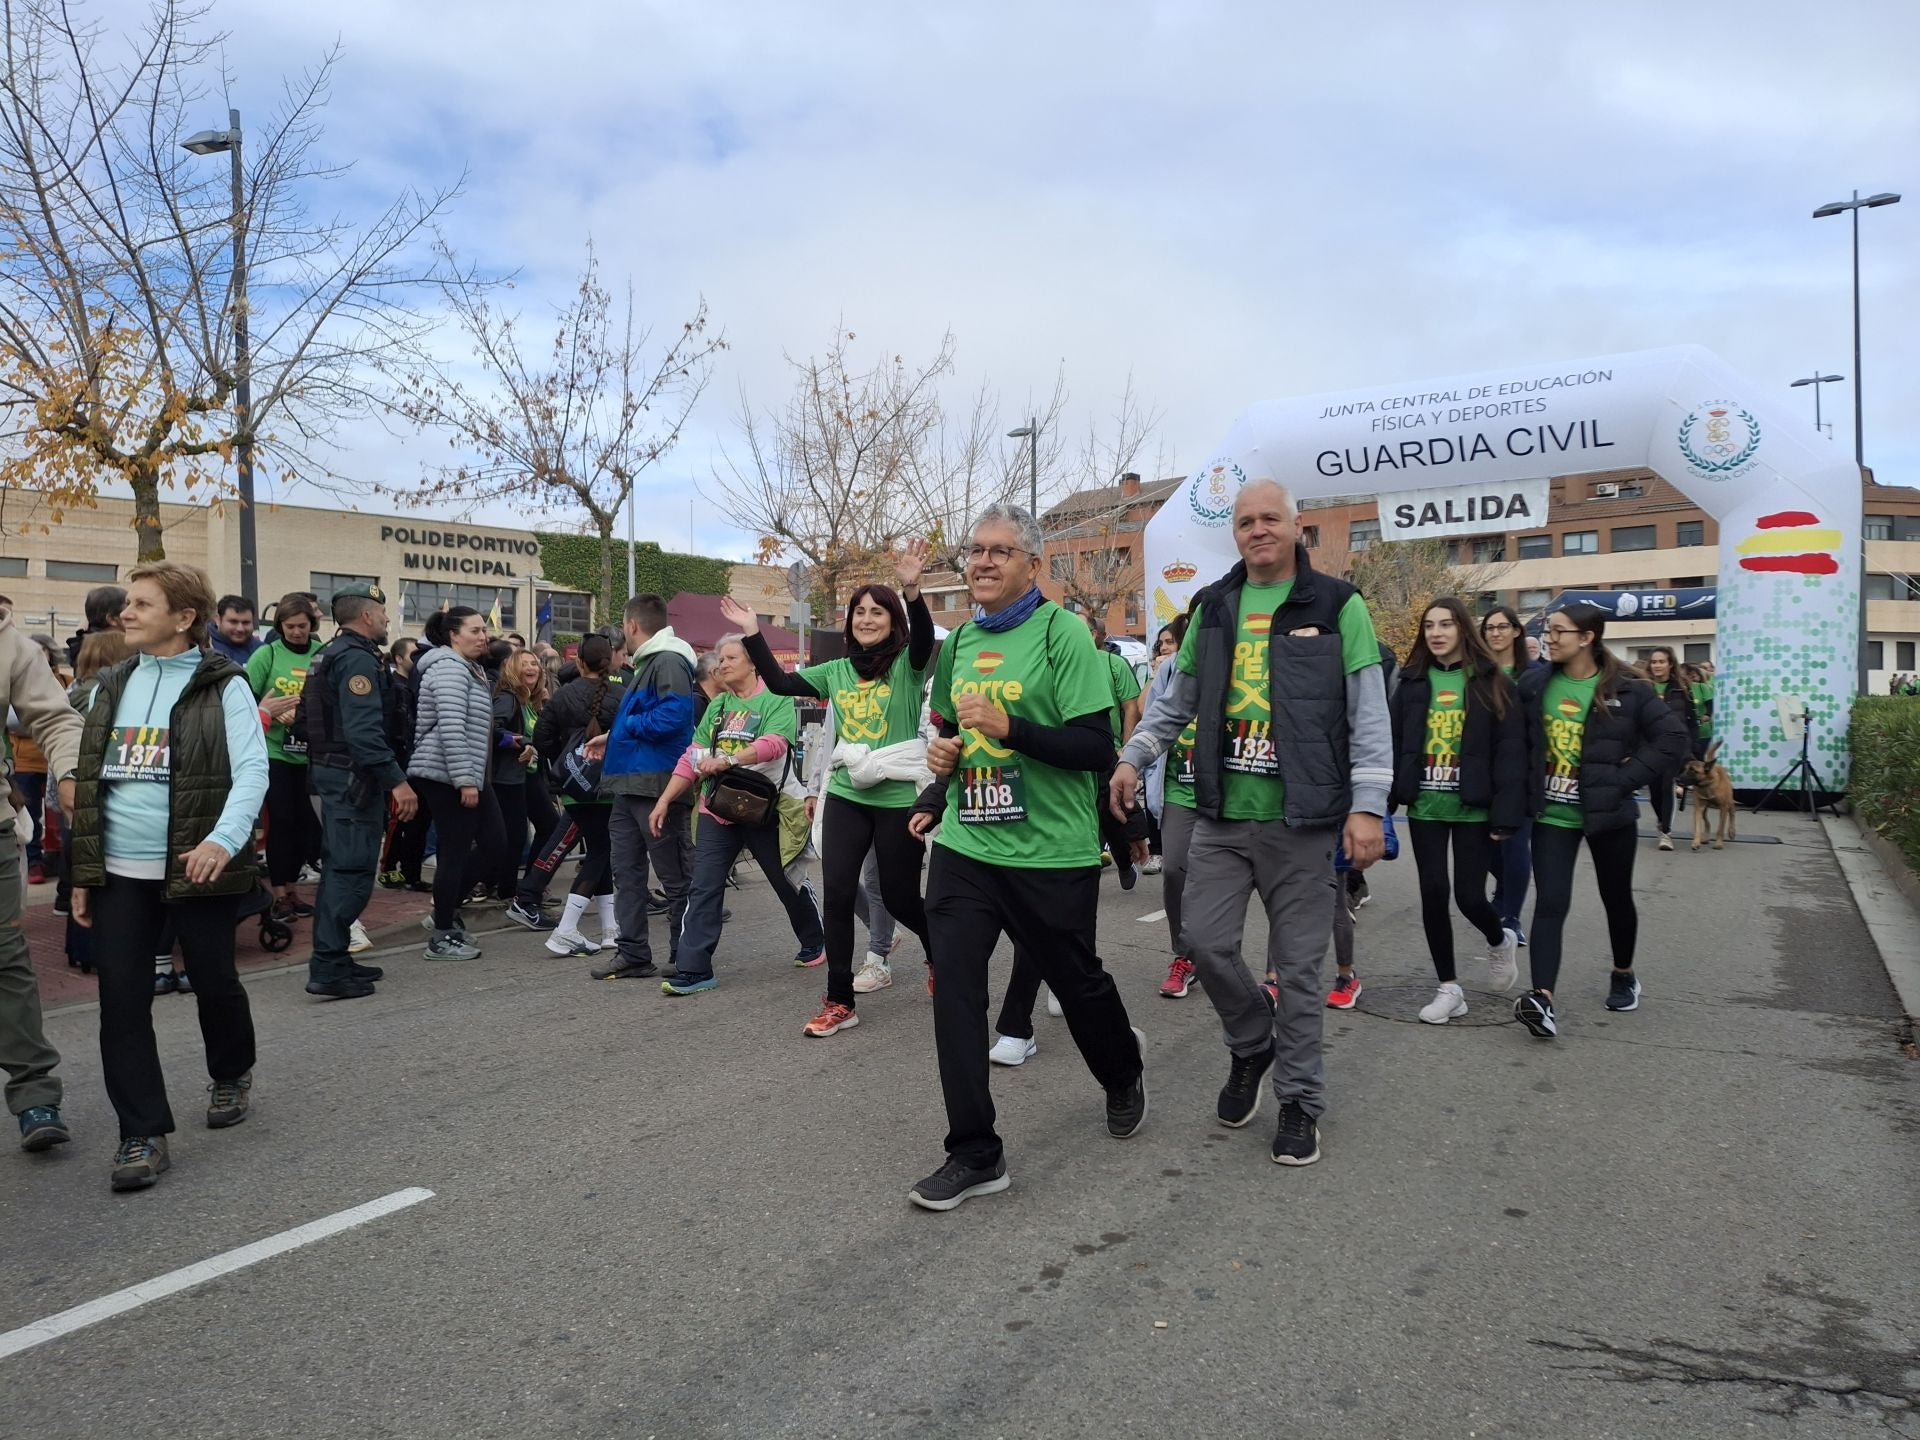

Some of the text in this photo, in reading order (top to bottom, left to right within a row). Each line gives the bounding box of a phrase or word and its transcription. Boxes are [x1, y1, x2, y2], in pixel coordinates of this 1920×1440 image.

[1320, 369, 1613, 419] JUNTA CENTRAL DE EDUCACIÓN
[1371, 397, 1548, 432] FÍSICA Y DEPORTES
[1316, 419, 1615, 477] GUARDIA CIVIL
[1686, 459, 1760, 482] GUARDIA CIVIL
[1190, 514, 1227, 529] GUARDIA
[1394, 493, 1531, 529] SALIDA
[381, 525, 538, 556] POLIDEPORTIVO
[404, 552, 516, 577] MUNICIPAL
[1642, 595, 1677, 609] FFD
[841, 698, 883, 719] TEA
[117, 743, 170, 768] 1371
[106, 771, 136, 779] GUARDIA
[137, 773, 156, 781] CIVIL
[107, 764, 139, 773] CARRERA
[1424, 765, 1461, 781] 1071
[1544, 774, 1580, 794] 1072
[964, 784, 1013, 808] 1108
[961, 806, 1024, 816] CARRERA SOLIDARIA
